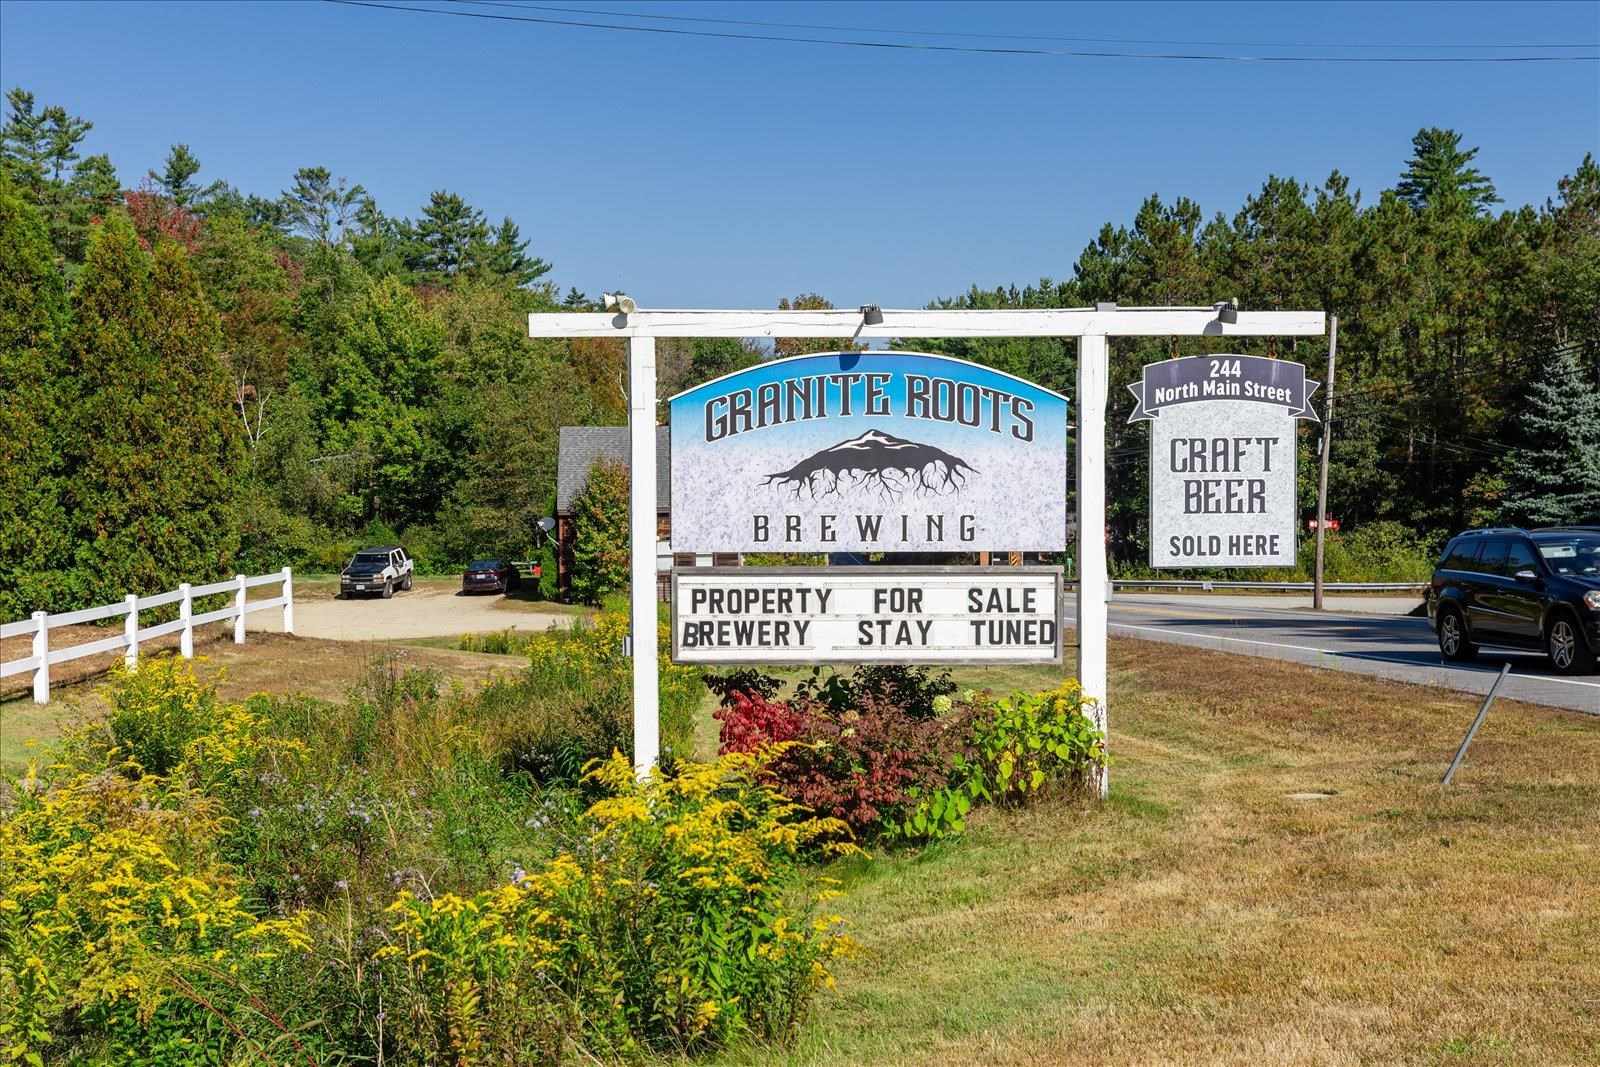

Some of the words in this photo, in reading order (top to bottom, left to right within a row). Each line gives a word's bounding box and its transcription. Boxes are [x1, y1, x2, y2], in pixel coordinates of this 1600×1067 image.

[1210, 360, 1241, 377] 244
[1155, 380, 1198, 404] North
[1203, 380, 1240, 397] Main
[1244, 380, 1292, 403] Street
[705, 373, 891, 442] GRANITE
[904, 374, 1035, 442] ROOTS
[1170, 437, 1280, 473] CRAFT
[1183, 479, 1267, 514] BEER
[754, 514, 976, 541] BREWING
[1169, 535, 1221, 556] SOLD
[1229, 535, 1280, 556] HERE
[691, 588, 832, 613] PROPERTY
[874, 588, 923, 613] FOR
[968, 588, 1036, 613] SALE
[682, 620, 811, 647] BREWERY
[858, 620, 932, 645] STAY
[970, 620, 1056, 645] TUNED
